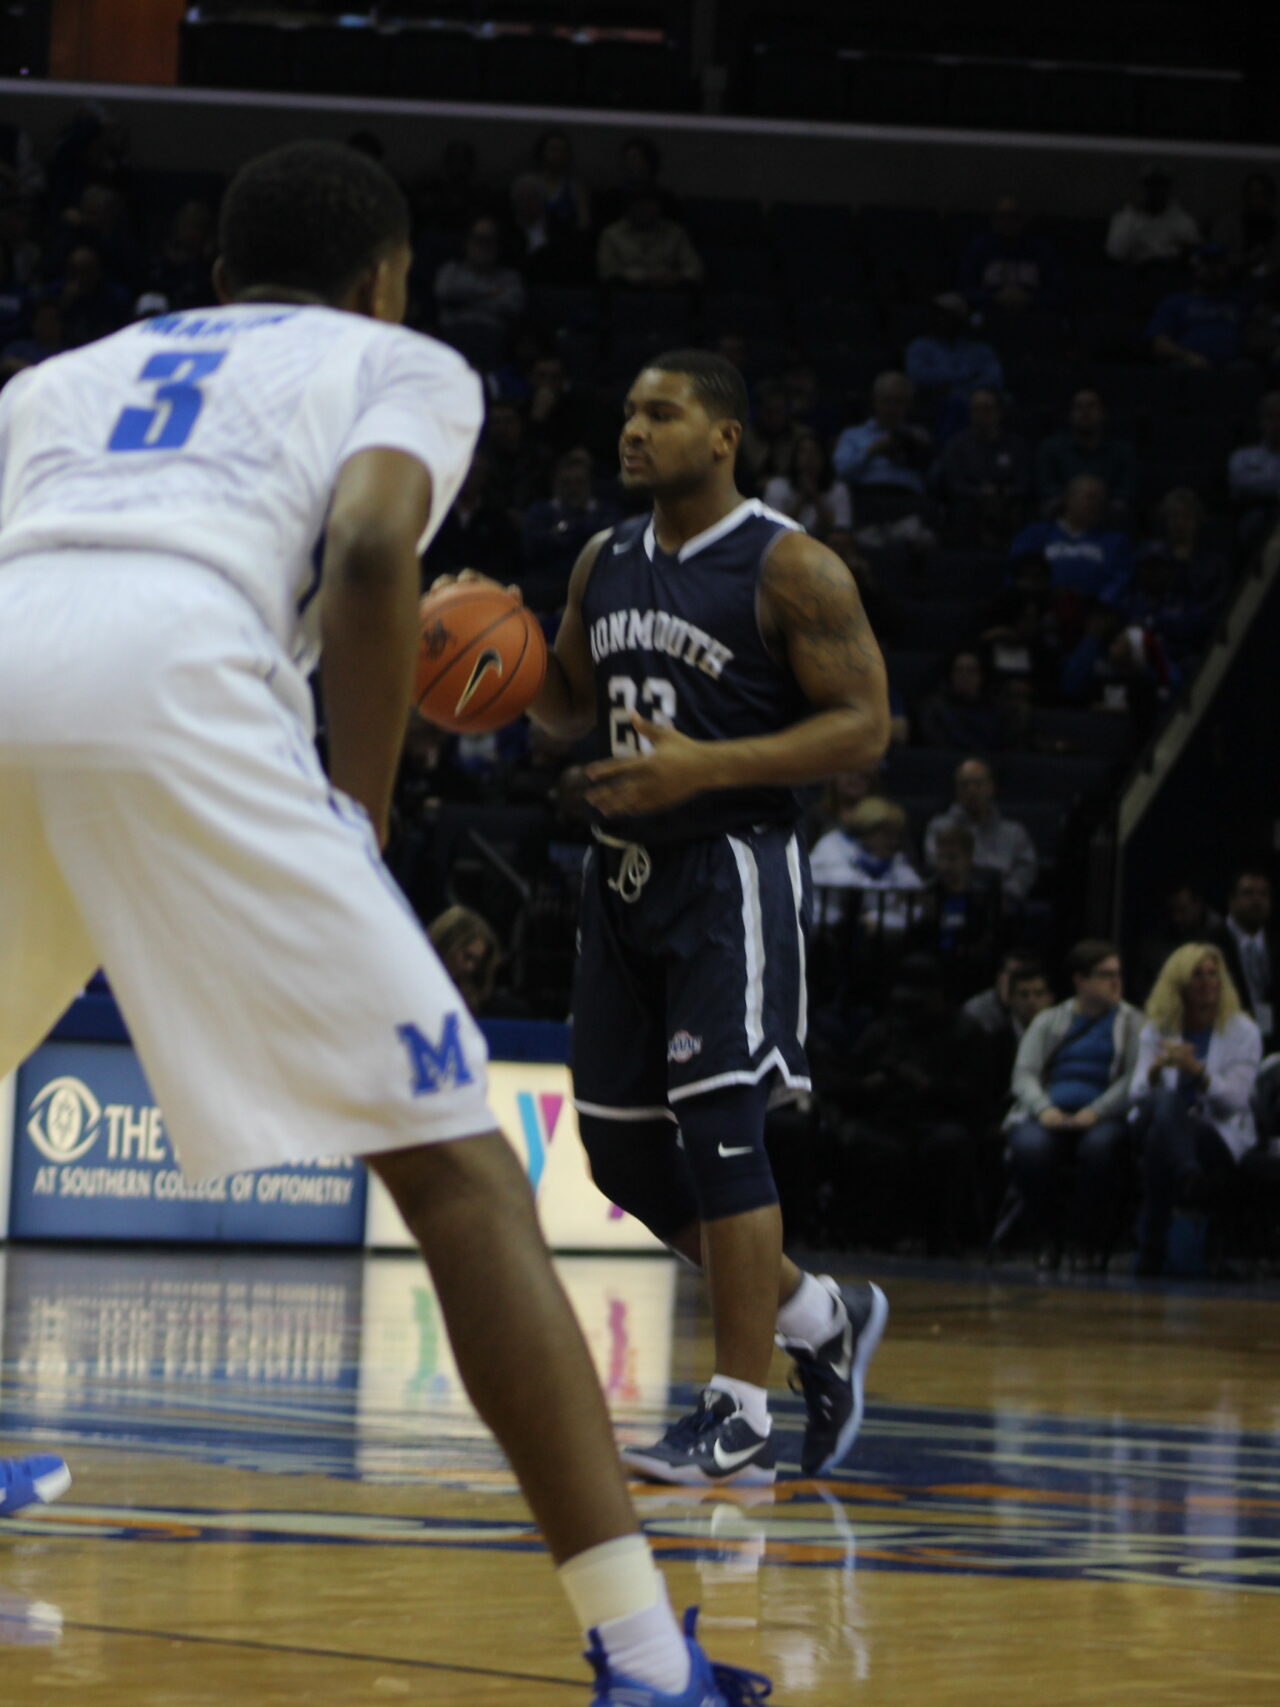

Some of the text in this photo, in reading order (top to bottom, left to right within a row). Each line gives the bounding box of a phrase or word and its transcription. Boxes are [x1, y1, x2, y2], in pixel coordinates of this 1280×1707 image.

[106, 351, 230, 452] 3
[395, 1010, 473, 1097] M
[104, 1104, 166, 1161] THE
[32, 1166, 57, 1195] AT
[60, 1167, 151, 1199] SOUTHERN
[231, 1173, 255, 1204] OF
[257, 1174, 354, 1206] OPTOMETRY
